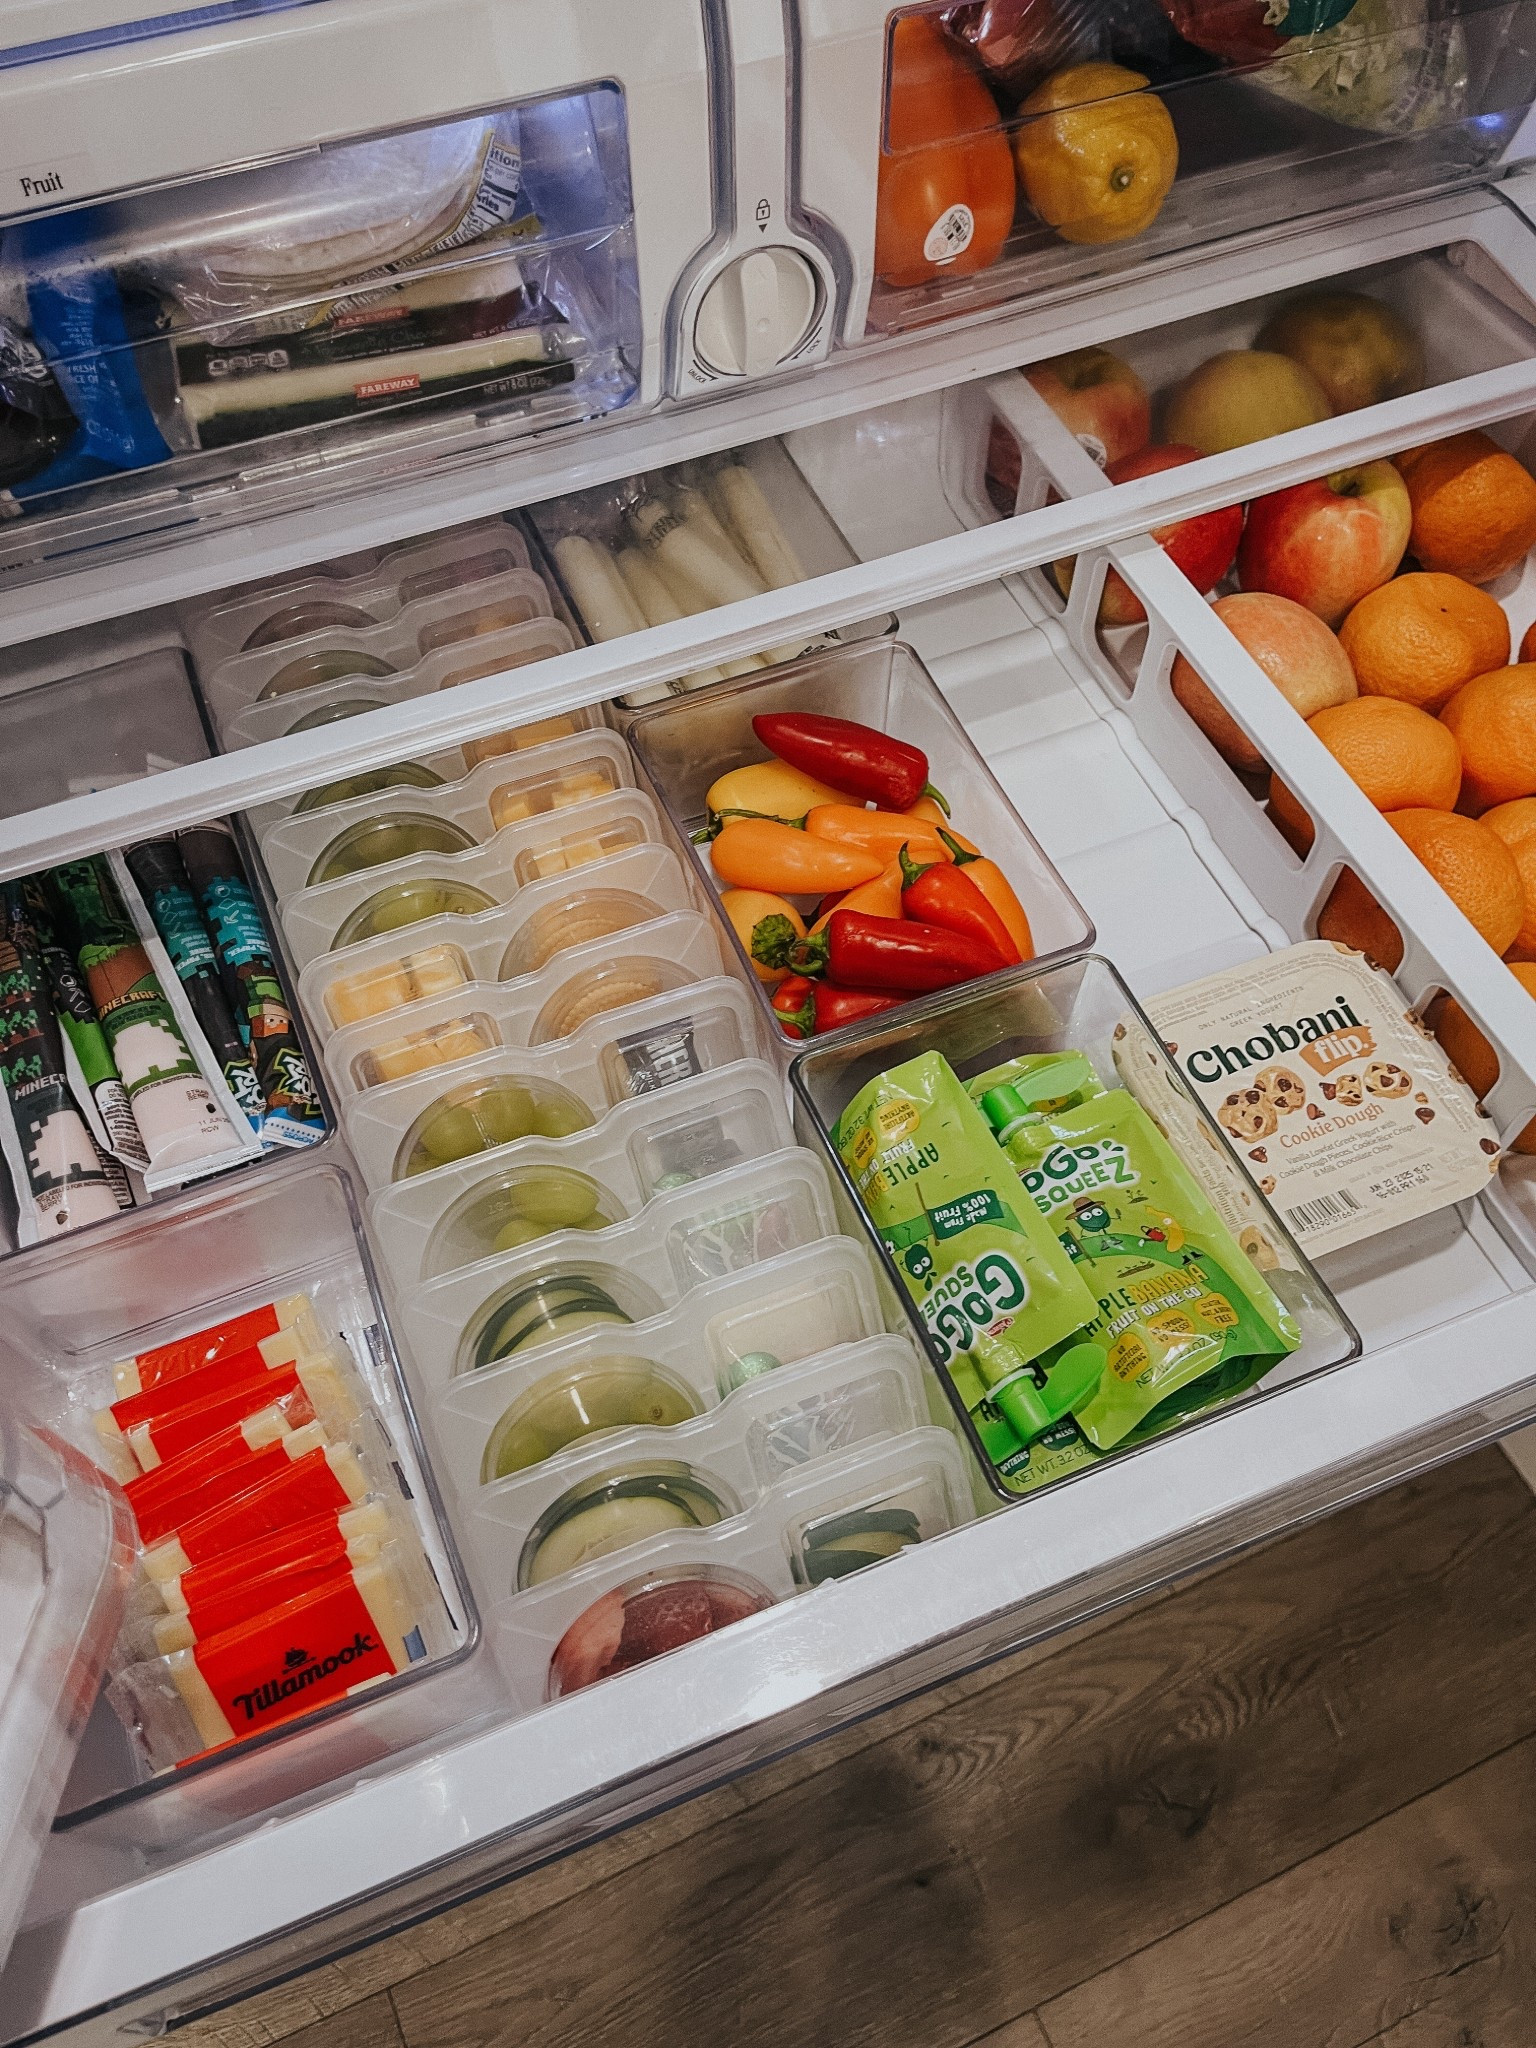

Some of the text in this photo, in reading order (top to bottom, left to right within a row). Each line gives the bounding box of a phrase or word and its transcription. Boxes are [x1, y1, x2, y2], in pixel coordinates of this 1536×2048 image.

[19, 172, 64, 197] Fruit
[359, 376, 417, 396] FAREWAY
[99, 990, 166, 1019] INECRAF
[1197, 1018, 1217, 1031] ONLY
[1219, 1005, 1252, 1022] NATURAL
[1228, 1001, 1284, 1028] GREEK YOGURT
[1187, 996, 1363, 1084] Chobani
[14, 1073, 67, 1101] MINECR
[1278, 1098, 1386, 1151] Cookie Dough
[1284, 1118, 1397, 1167] Vanilla Lowfat Greek Yogurt with
[882, 1142, 940, 1186] APPLE
[1277, 1162, 1305, 1180] Cookie
[1303, 1154, 1329, 1172] Dough
[1319, 1163, 1336, 1175] Milk
[1334, 1148, 1373, 1169] Chocolate
[1370, 1140, 1393, 1156] Chips
[932, 1192, 992, 1223] 100% Fruit
[1033, 1160, 1134, 1213] SQUEEZ
[918, 1265, 975, 1327] SQUE
[1127, 1258, 1209, 1306] BANANA
[1104, 1284, 1202, 1338] FRUIT ON THE GO
[1012, 1467, 1037, 1487] NET
[1072, 1442, 1091, 1458] OZ
[233, 1633, 379, 1721] Tillamook
